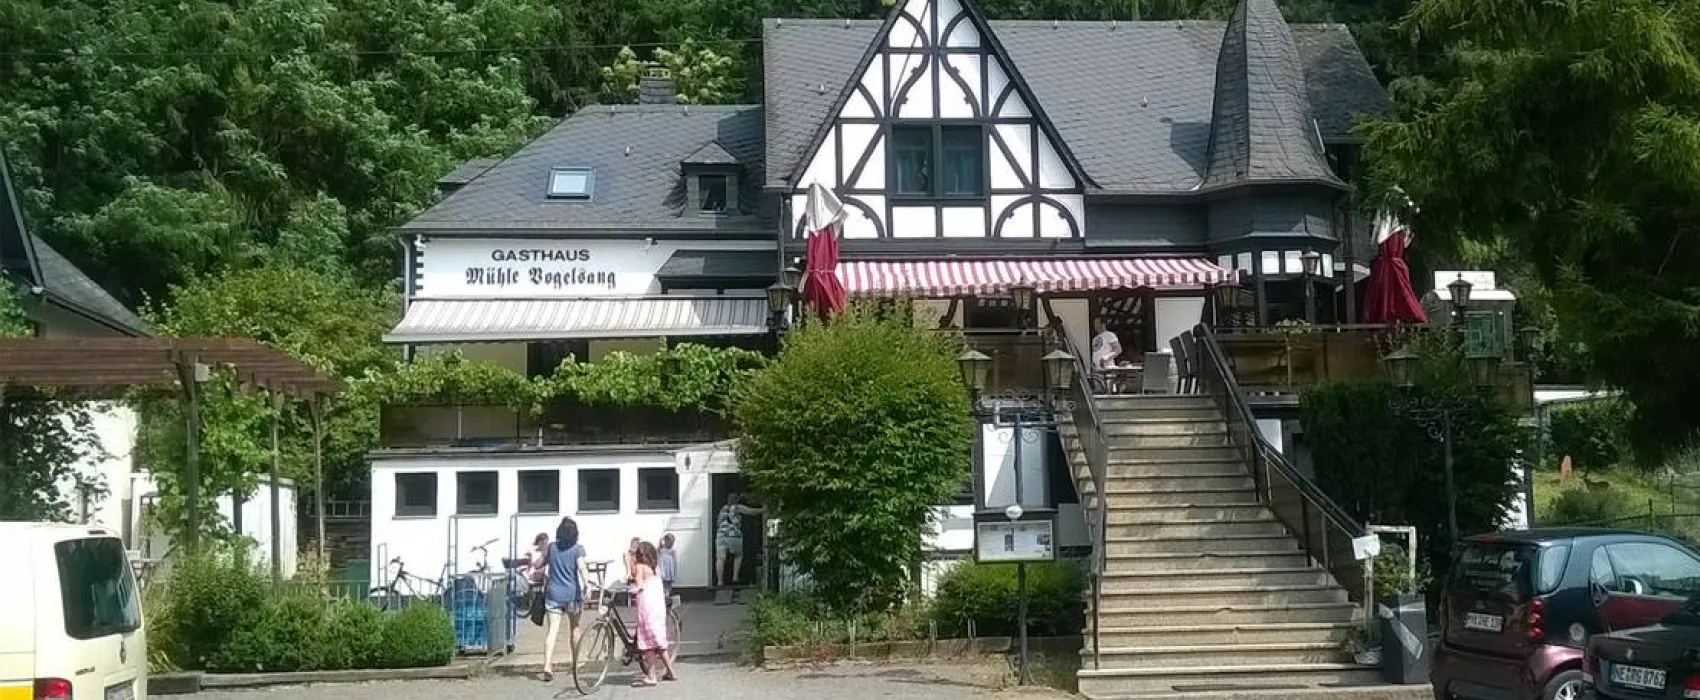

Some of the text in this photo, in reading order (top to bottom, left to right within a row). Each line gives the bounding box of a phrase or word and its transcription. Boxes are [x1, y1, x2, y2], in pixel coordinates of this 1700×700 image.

[491, 249, 590, 262] GASTHAUS
[465, 267, 616, 289] Mühle Vogelsang
